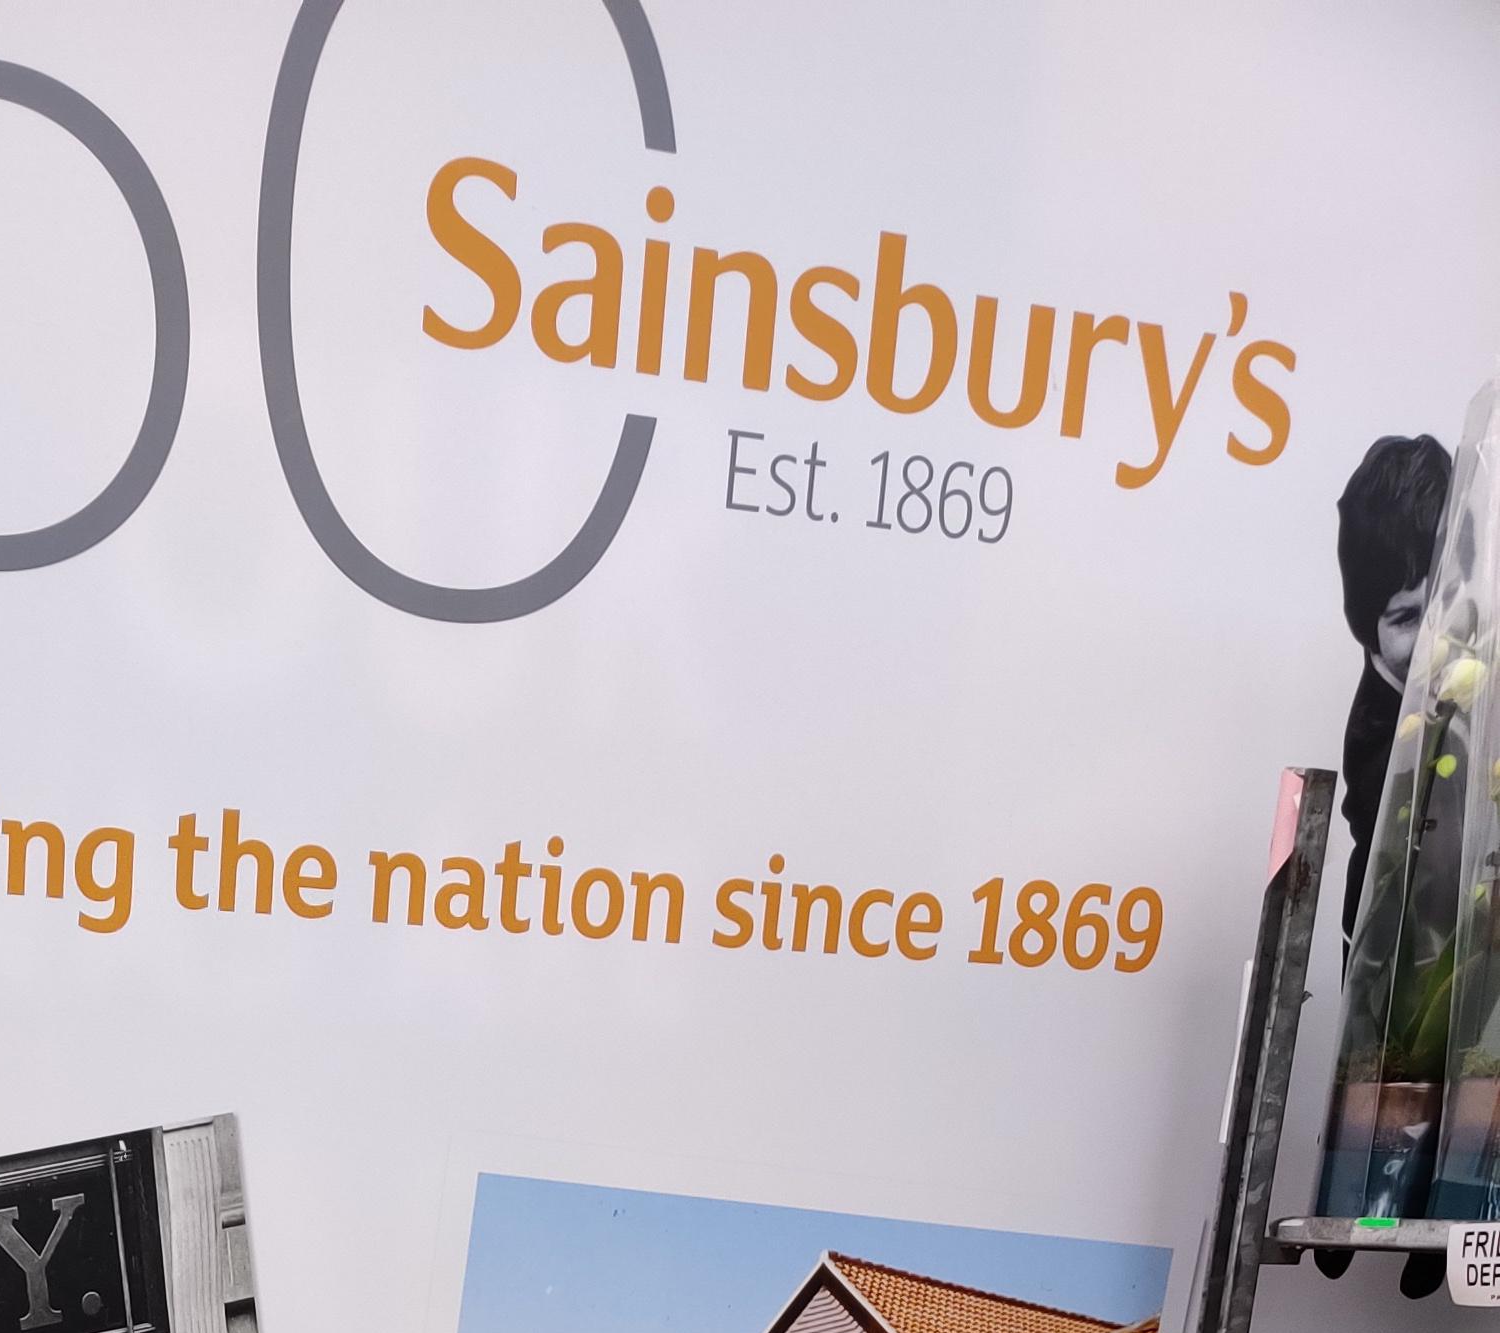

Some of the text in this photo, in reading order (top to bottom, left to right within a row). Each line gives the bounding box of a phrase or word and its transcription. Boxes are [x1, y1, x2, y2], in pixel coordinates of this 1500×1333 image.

[420, 154, 1298, 492] Sainsbury's
[722, 428, 1014, 546] Est. 1869
[169, 805, 337, 921] the
[368, 834, 689, 953] nation
[711, 852, 943, 964] since
[967, 877, 1164, 976] 1869
